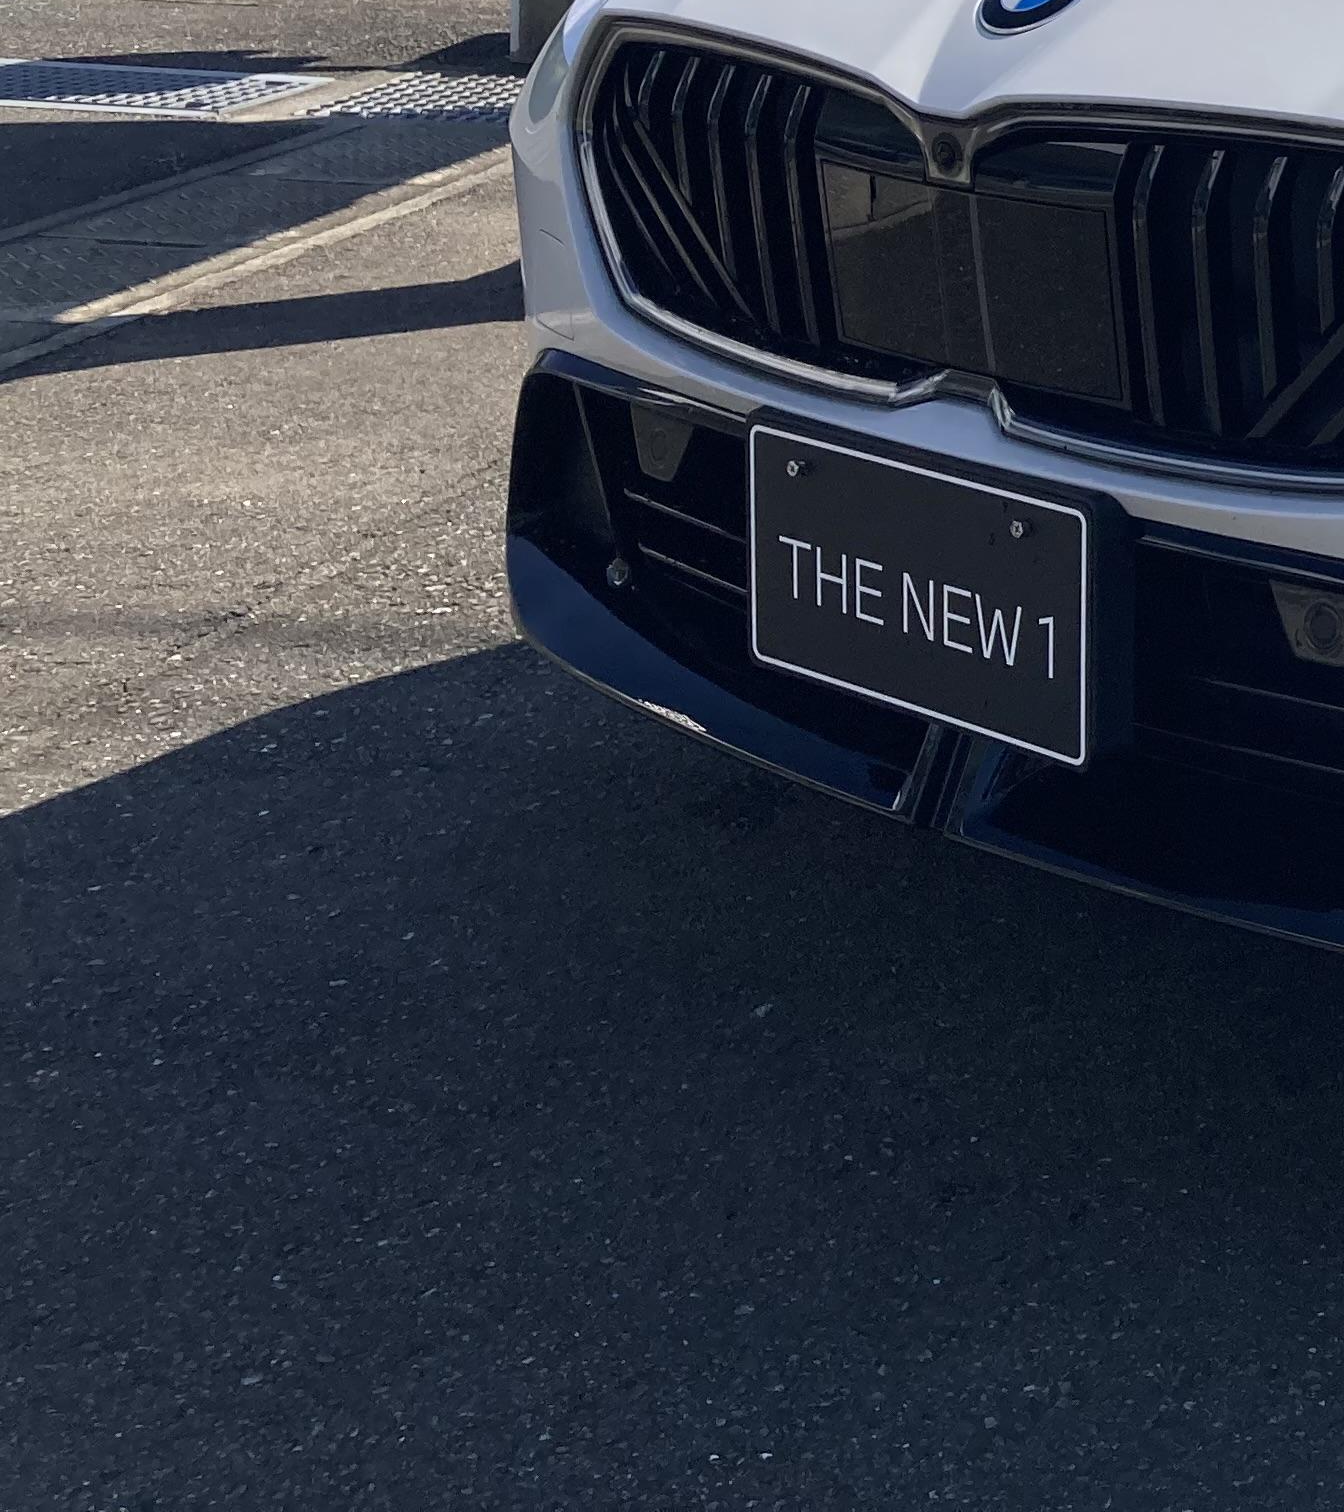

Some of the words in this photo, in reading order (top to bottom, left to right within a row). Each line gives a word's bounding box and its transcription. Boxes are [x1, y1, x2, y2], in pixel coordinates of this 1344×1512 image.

[778, 535, 885, 626] THE
[902, 571, 1022, 667] NEW
[1038, 616, 1057, 679] 1
